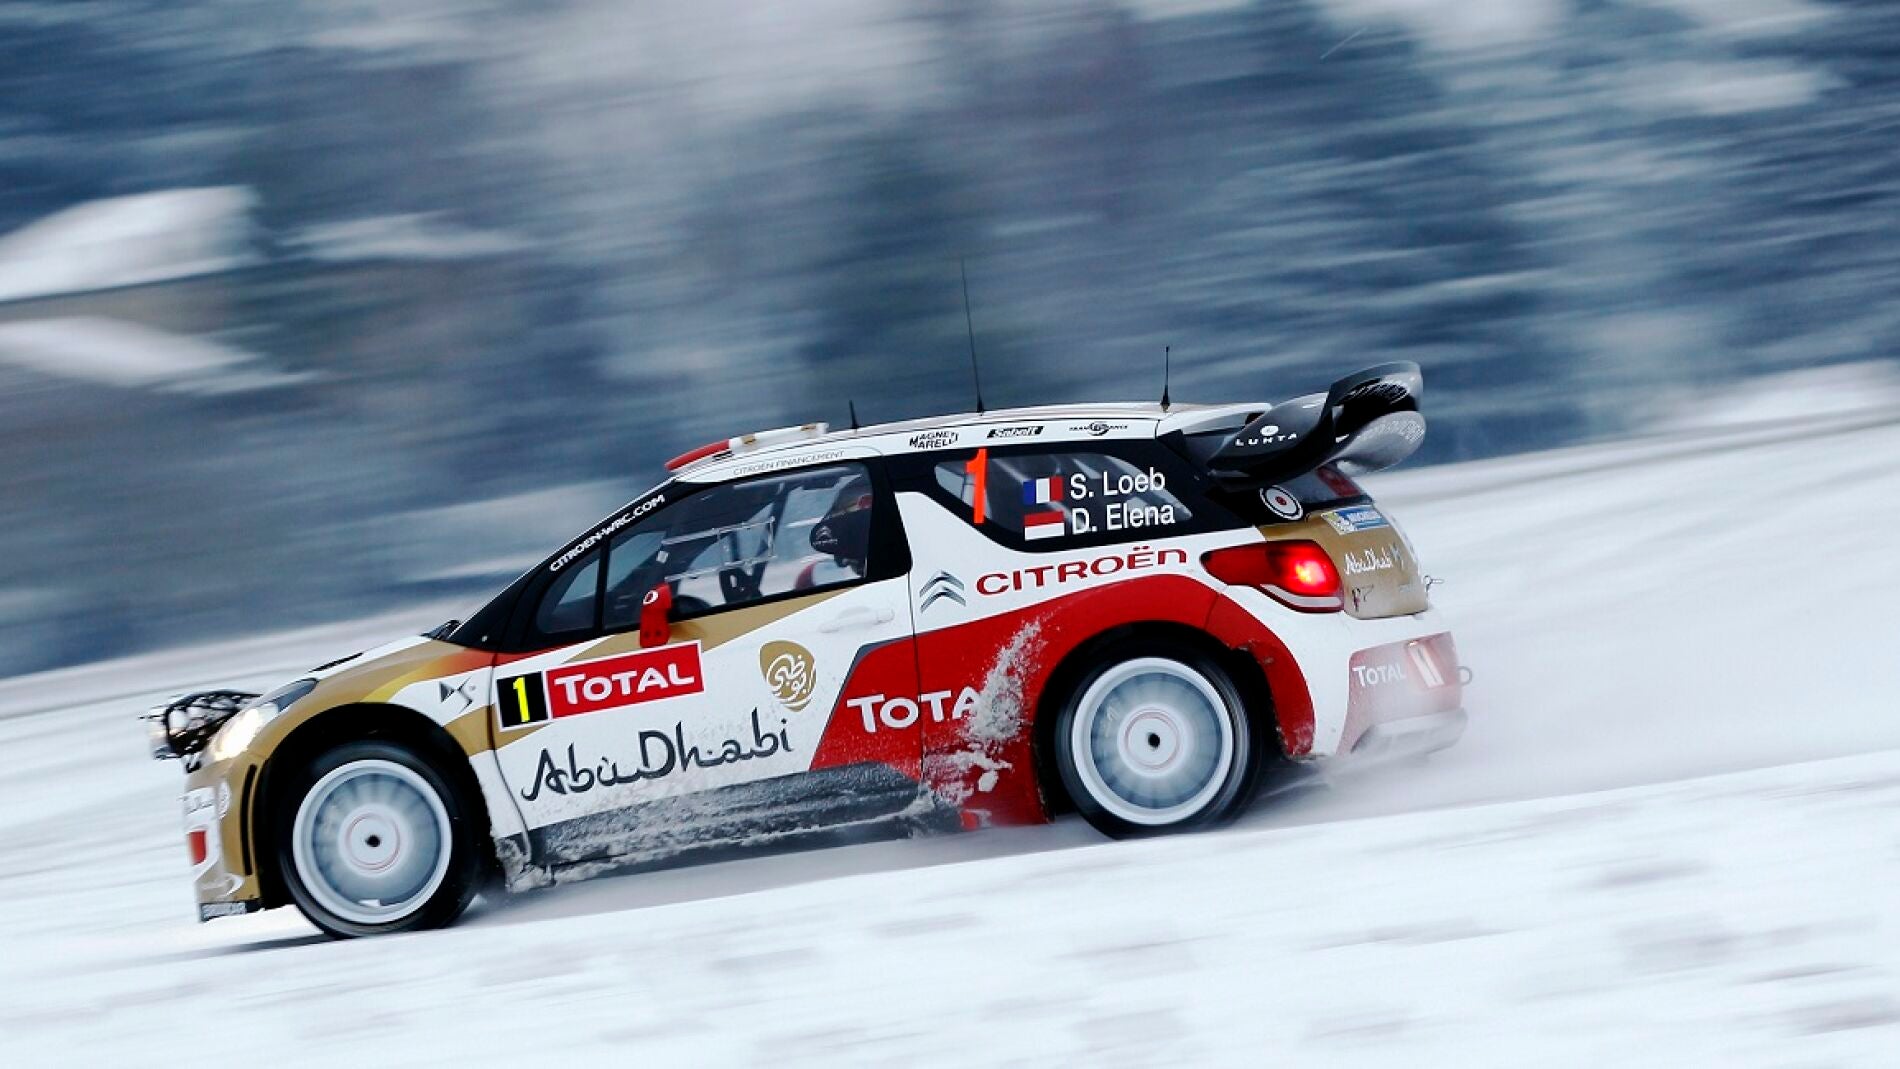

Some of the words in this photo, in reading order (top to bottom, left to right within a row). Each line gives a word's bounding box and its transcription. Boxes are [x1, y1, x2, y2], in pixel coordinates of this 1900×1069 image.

[776, 451, 845, 468] FINANCEMENT
[965, 448, 988, 525] 1
[1070, 473, 1094, 500] S.
[1103, 466, 1166, 496] Loeb
[1071, 507, 1098, 535] D.
[1106, 502, 1176, 531] Elena
[512, 676, 530, 723] 1
